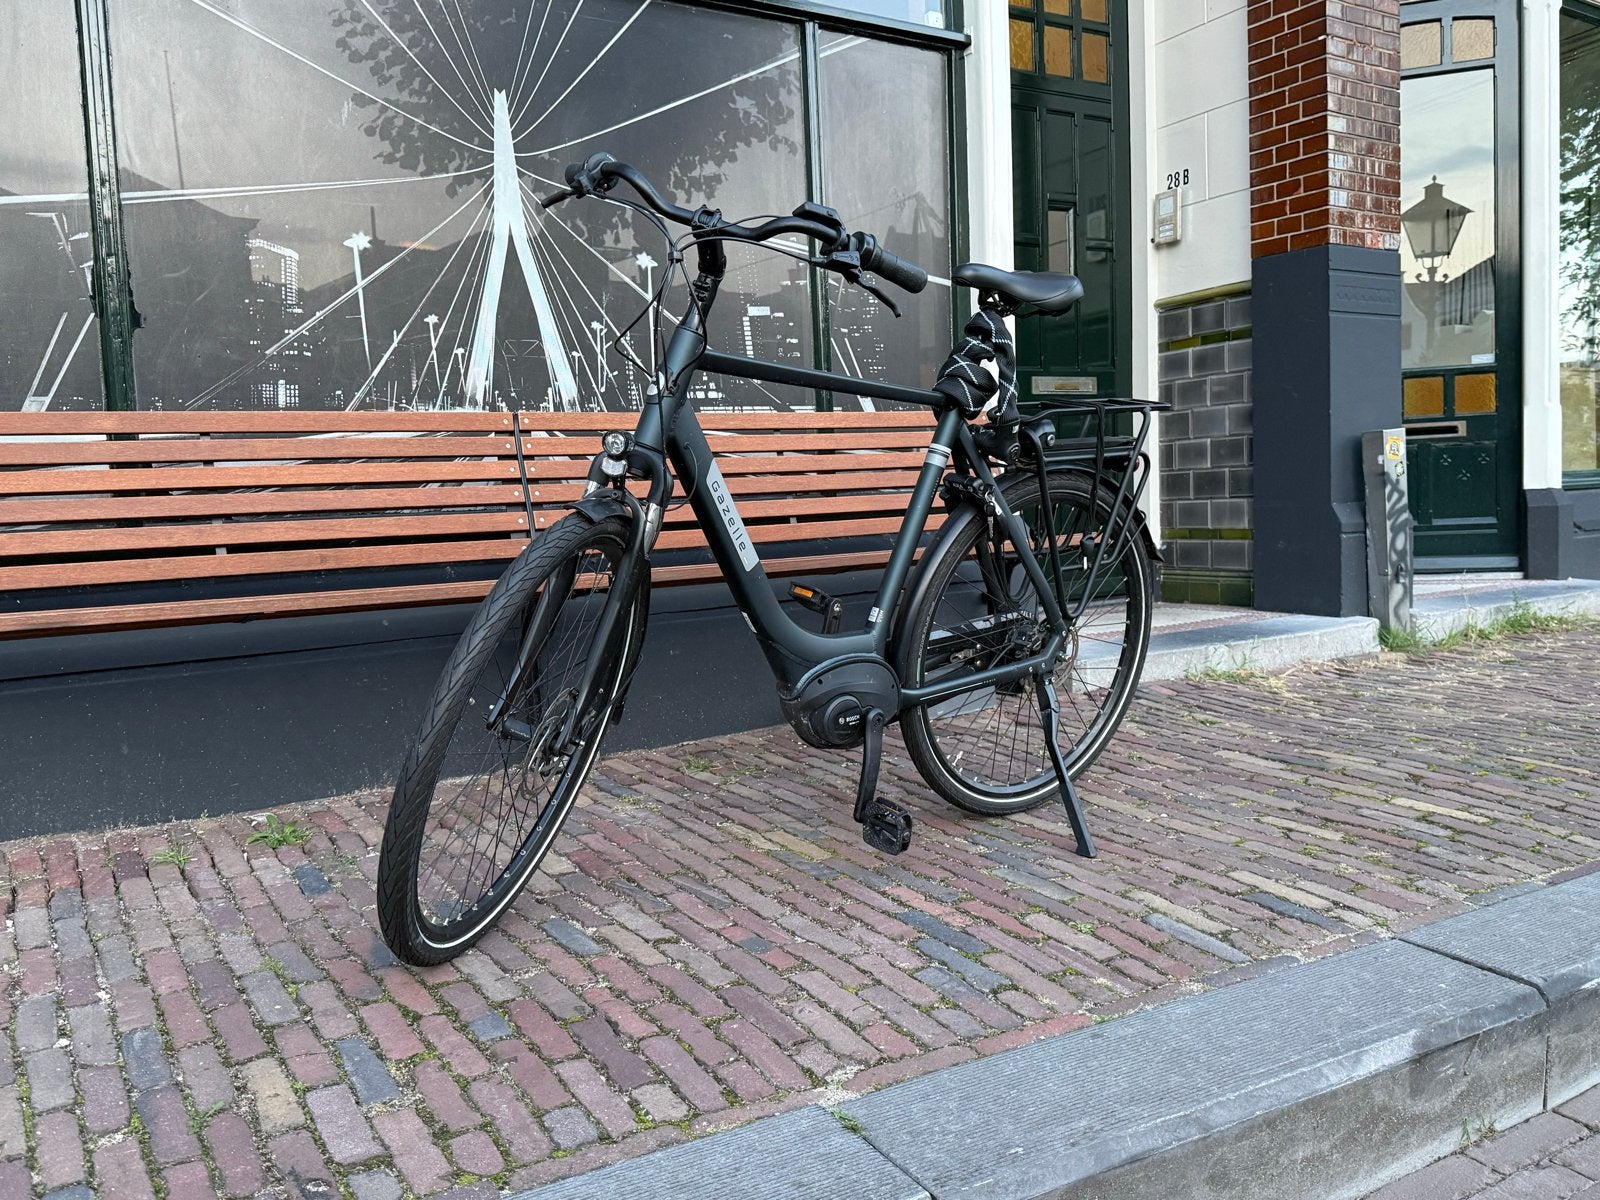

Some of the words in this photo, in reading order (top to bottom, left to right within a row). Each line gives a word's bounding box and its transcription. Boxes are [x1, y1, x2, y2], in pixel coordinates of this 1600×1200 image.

[1167, 171, 1180, 190] 28
[1183, 168, 1189, 186] B
[711, 480, 747, 552] Gazelle
[845, 714, 860, 722] BOSCH
